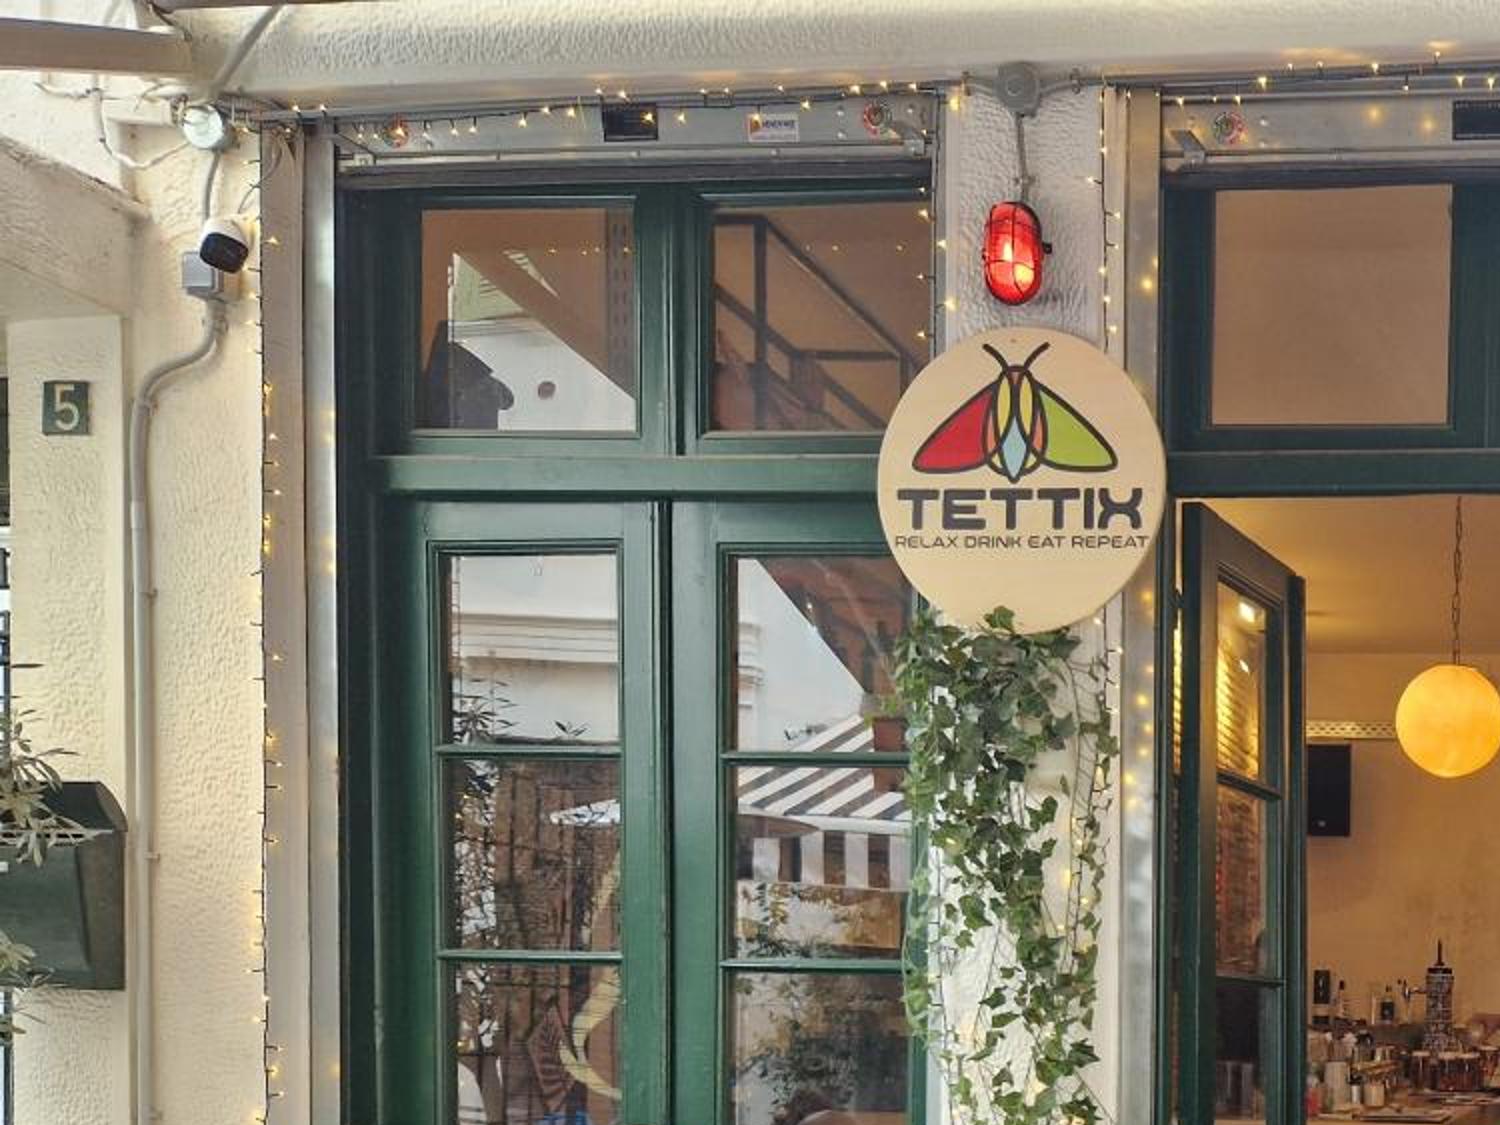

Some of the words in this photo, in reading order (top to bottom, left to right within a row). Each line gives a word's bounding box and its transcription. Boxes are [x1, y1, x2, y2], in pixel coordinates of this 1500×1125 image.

[54, 383, 80, 431] 5
[897, 487, 1144, 531] TETTIX
[895, 535, 959, 549] RELAX
[964, 535, 1022, 549] DRINK
[1027, 535, 1066, 549] EAT
[1071, 535, 1150, 549] REPEAT
